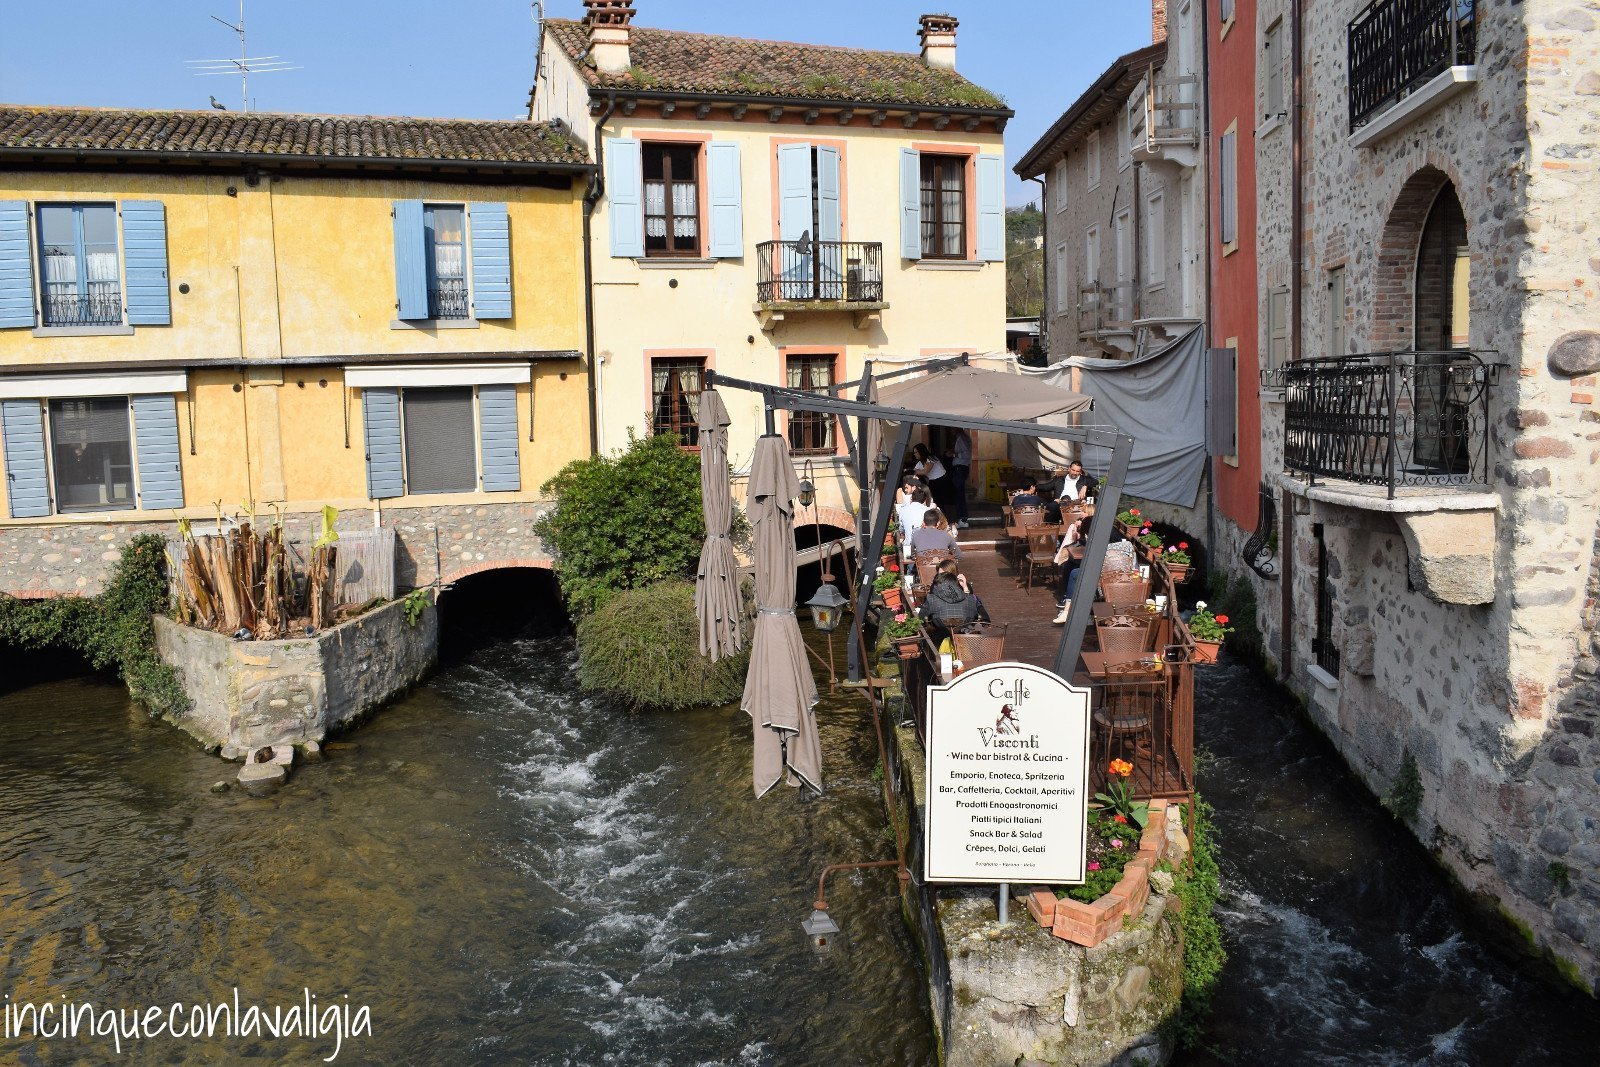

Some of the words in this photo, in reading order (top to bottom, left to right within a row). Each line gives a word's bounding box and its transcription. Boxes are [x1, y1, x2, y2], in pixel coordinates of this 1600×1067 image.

[988, 679, 1030, 706] Caffè
[977, 727, 1039, 748] Visconti
[951, 752, 974, 760] Wine
[993, 753, 1022, 761] bistrot
[1024, 753, 1030, 761] &
[989, 772, 1023, 780] Enoteca,
[1025, 773, 1064, 781] Spritzeria
[958, 786, 1002, 794] Caffetteria,
[1004, 787, 1039, 796] Cocktail,
[1041, 788, 1075, 796] Aperitivi
[990, 802, 1058, 810] Enogastronomici
[993, 816, 1012, 824] tipici
[966, 845, 996, 853] Crêpes,
[998, 845, 1020, 853] Dolci,
